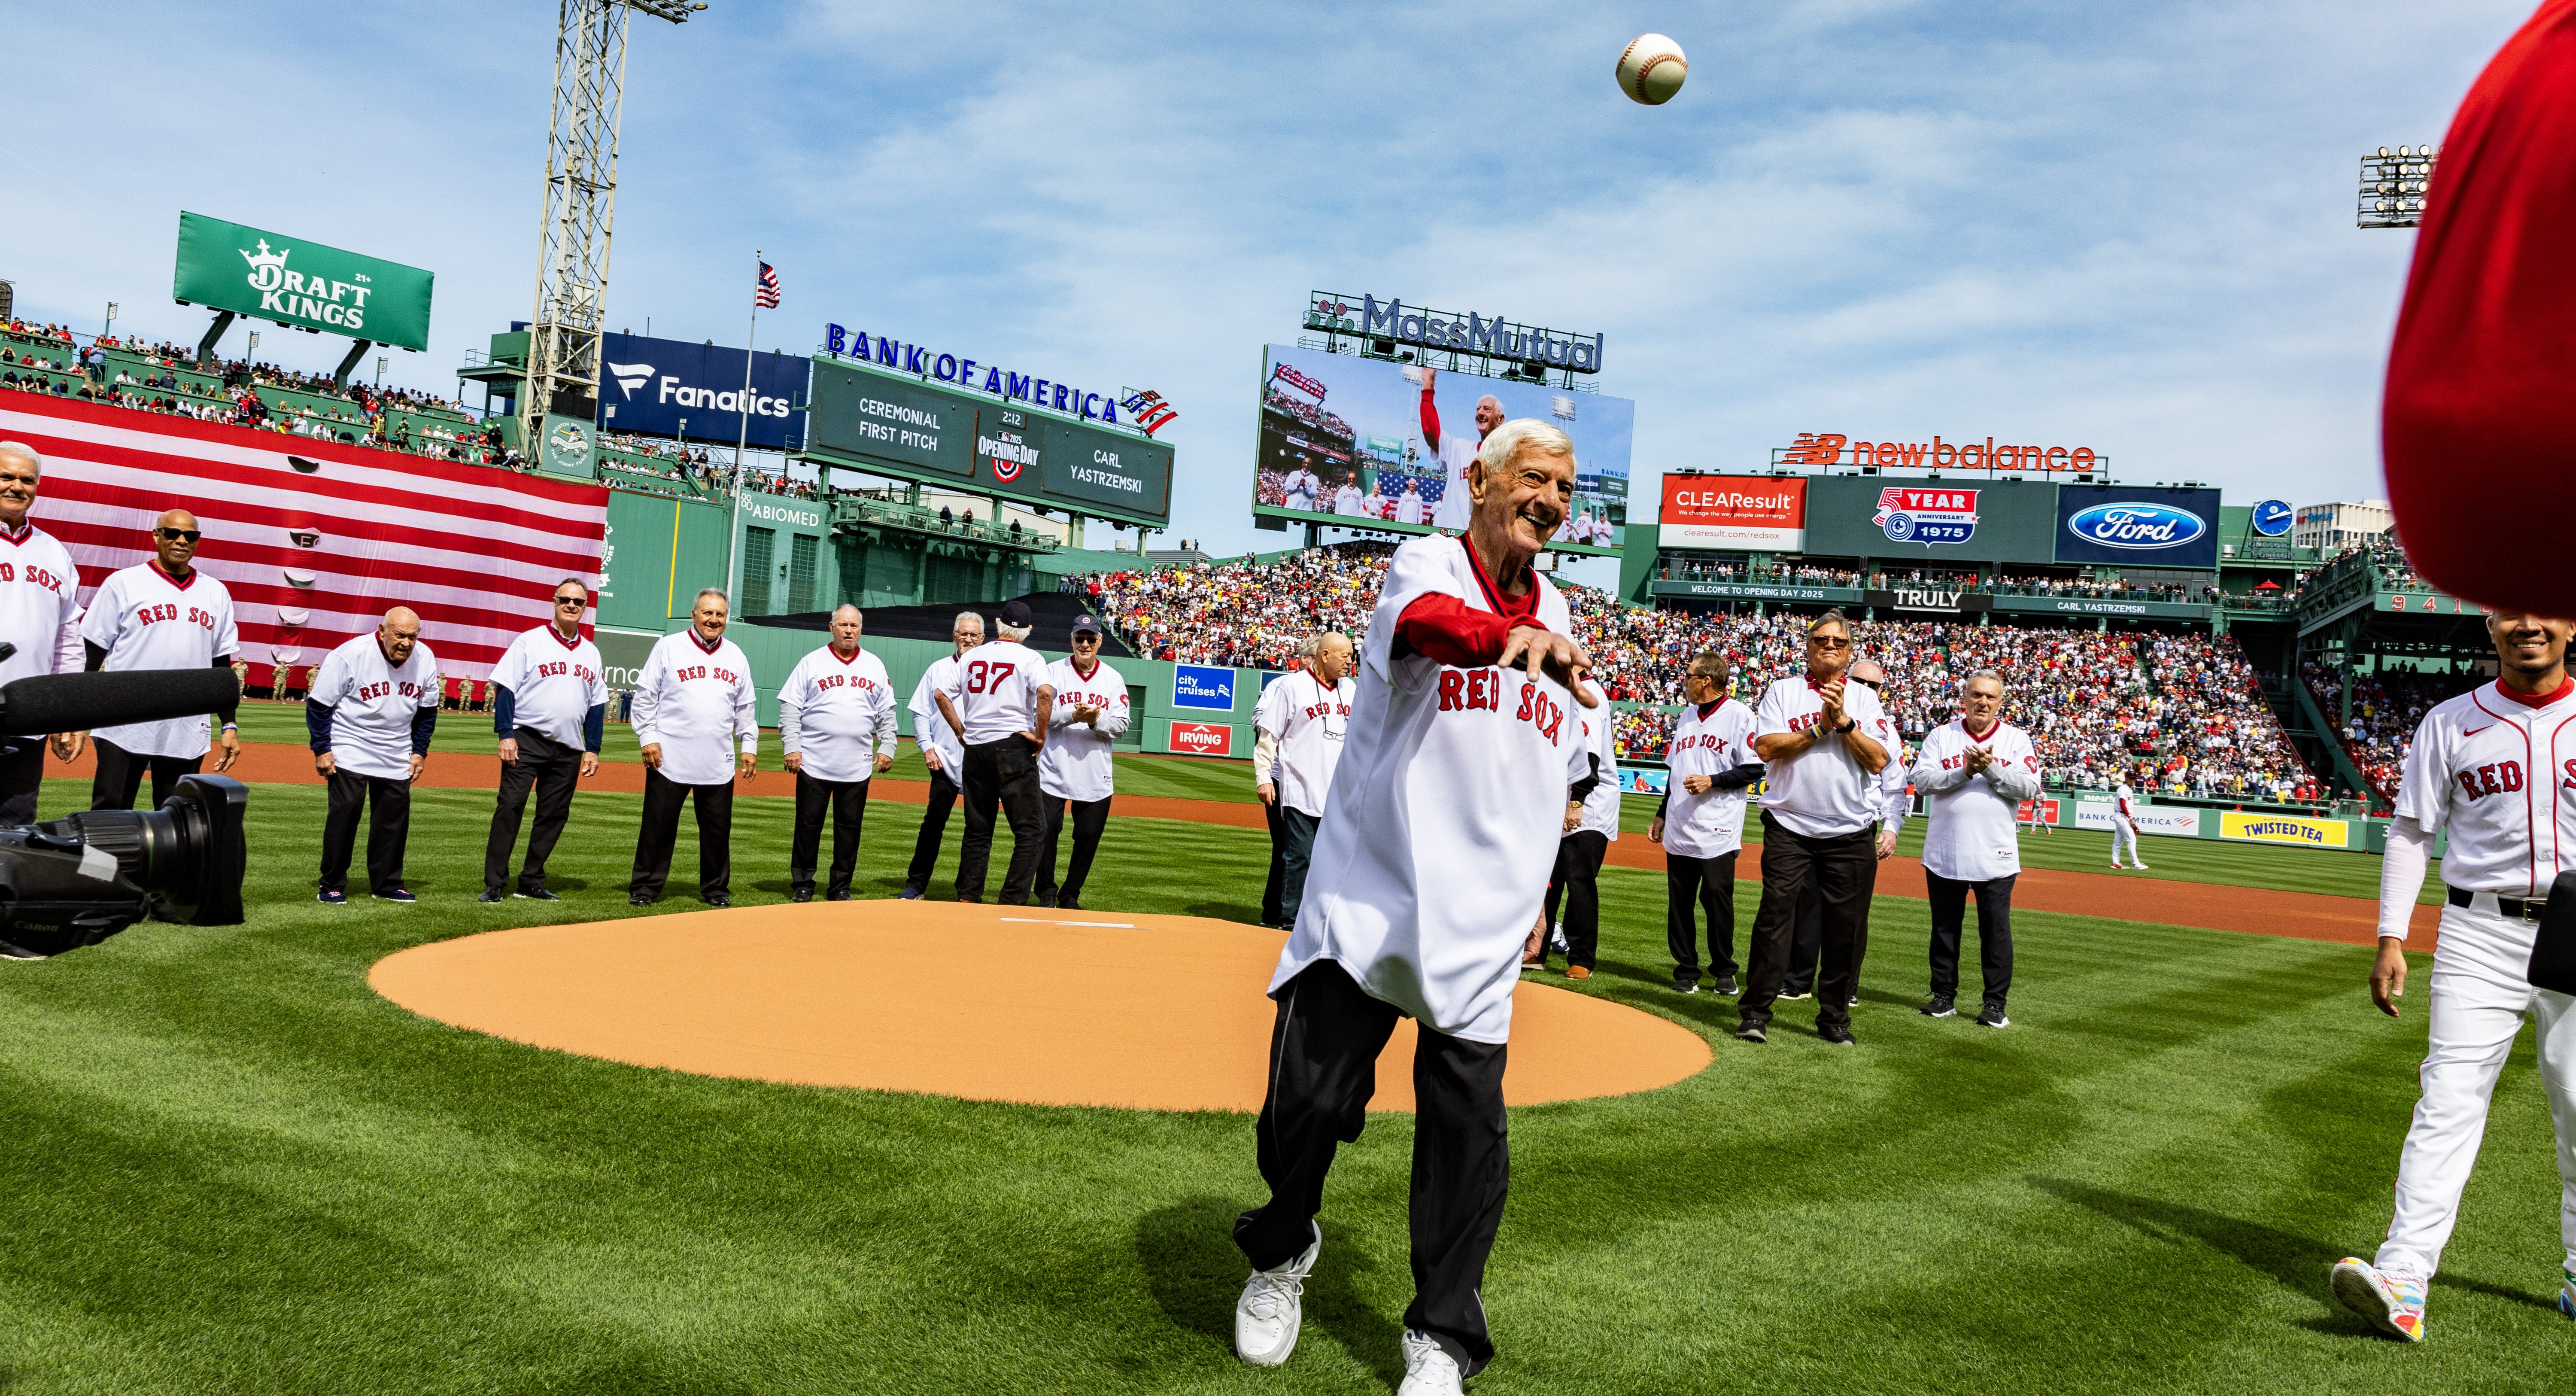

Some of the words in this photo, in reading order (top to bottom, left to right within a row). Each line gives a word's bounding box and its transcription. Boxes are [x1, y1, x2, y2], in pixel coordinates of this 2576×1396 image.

[248, 264, 371, 307] DRAFT
[355, 273, 371, 282] 21+
[259, 289, 363, 329] KINGS
[1362, 293, 1603, 371] MassMutual
[824, 322, 925, 374] BANK
[933, 353, 976, 386] OF
[981, 366, 1117, 424] AMERICA
[659, 375, 790, 418] Fanatics
[860, 398, 940, 429] CEREMONIAL
[1002, 411, 1021, 425] 2:12
[552, 422, 569, 434] BOSTON
[580, 429, 588, 440] SOX
[860, 420, 896, 442] FIRST
[901, 430, 937, 451] PITCH
[1010, 434, 1022, 444] 2025
[552, 438, 569, 447] TOGETHER
[978, 435, 1020, 462] OPENING
[1020, 445, 1039, 466] DAY
[576, 454, 587, 466] FUND
[1094, 450, 1121, 468] CARL
[1853, 441, 1928, 467] new
[1934, 435, 2095, 472] balance
[1071, 465, 1142, 493] YASTRZEMSKI
[1601, 468, 1619, 477] BANK
[1676, 491, 1791, 509] CLEAResult
[1908, 493, 1965, 508] YEAR
[752, 504, 819, 527] ABIOMED
[1578, 520, 1586, 528] 37
[1684, 528, 1780, 539] clearesult.com/redsox
[1921, 527, 1964, 537] 1975
[2096, 509, 2178, 541] Ford
[2245, 538, 2287, 548] Johnson
[2252, 549, 2295, 559] Controls
[26, 565, 62, 596] SOX
[1691, 585, 1728, 594] WELCOME
[1732, 587, 1742, 595] TO
[1744, 587, 1778, 596] OPENING
[1781, 589, 1798, 597] DAY
[1801, 590, 1823, 598] 2025
[1893, 589, 1962, 607] TRULY
[2057, 602, 2081, 611] CARL
[2084, 603, 2146, 613] YASTRZEMSKI
[2391, 595, 2406, 611] 9
[2423, 596, 2436, 612] 4
[2454, 598, 2462, 613] 1
[137, 604, 177, 626] RED
[538, 662, 567, 678] RED
[574, 664, 595, 687] SOX
[677, 666, 706, 682] RED
[713, 667, 738, 687] SOX
[967, 660, 1015, 695] 37
[1178, 675, 1198, 687] city
[359, 681, 390, 701] RED
[398, 681, 422, 700] SOX
[817, 675, 844, 691] RED
[851, 676, 875, 693] SOX
[1178, 686, 1215, 696] cruises
[1059, 691, 1081, 706] RED
[1088, 693, 1109, 710] SOX
[1438, 667, 1499, 712] RED
[1516, 683, 1563, 747] SOX
[1305, 702, 1330, 720] RED
[1179, 732, 1221, 745] IRVING
[1676, 735, 1695, 755] RED
[1699, 734, 1728, 754] SOX
[1941, 754, 1966, 770] RE
[2458, 760, 2523, 802] RED
[2133, 816, 2171, 825] MERICA
[2244, 822, 2298, 837] TWISTED
[2301, 825, 2323, 842] TEA
[14, 921, 59, 932] Canon
